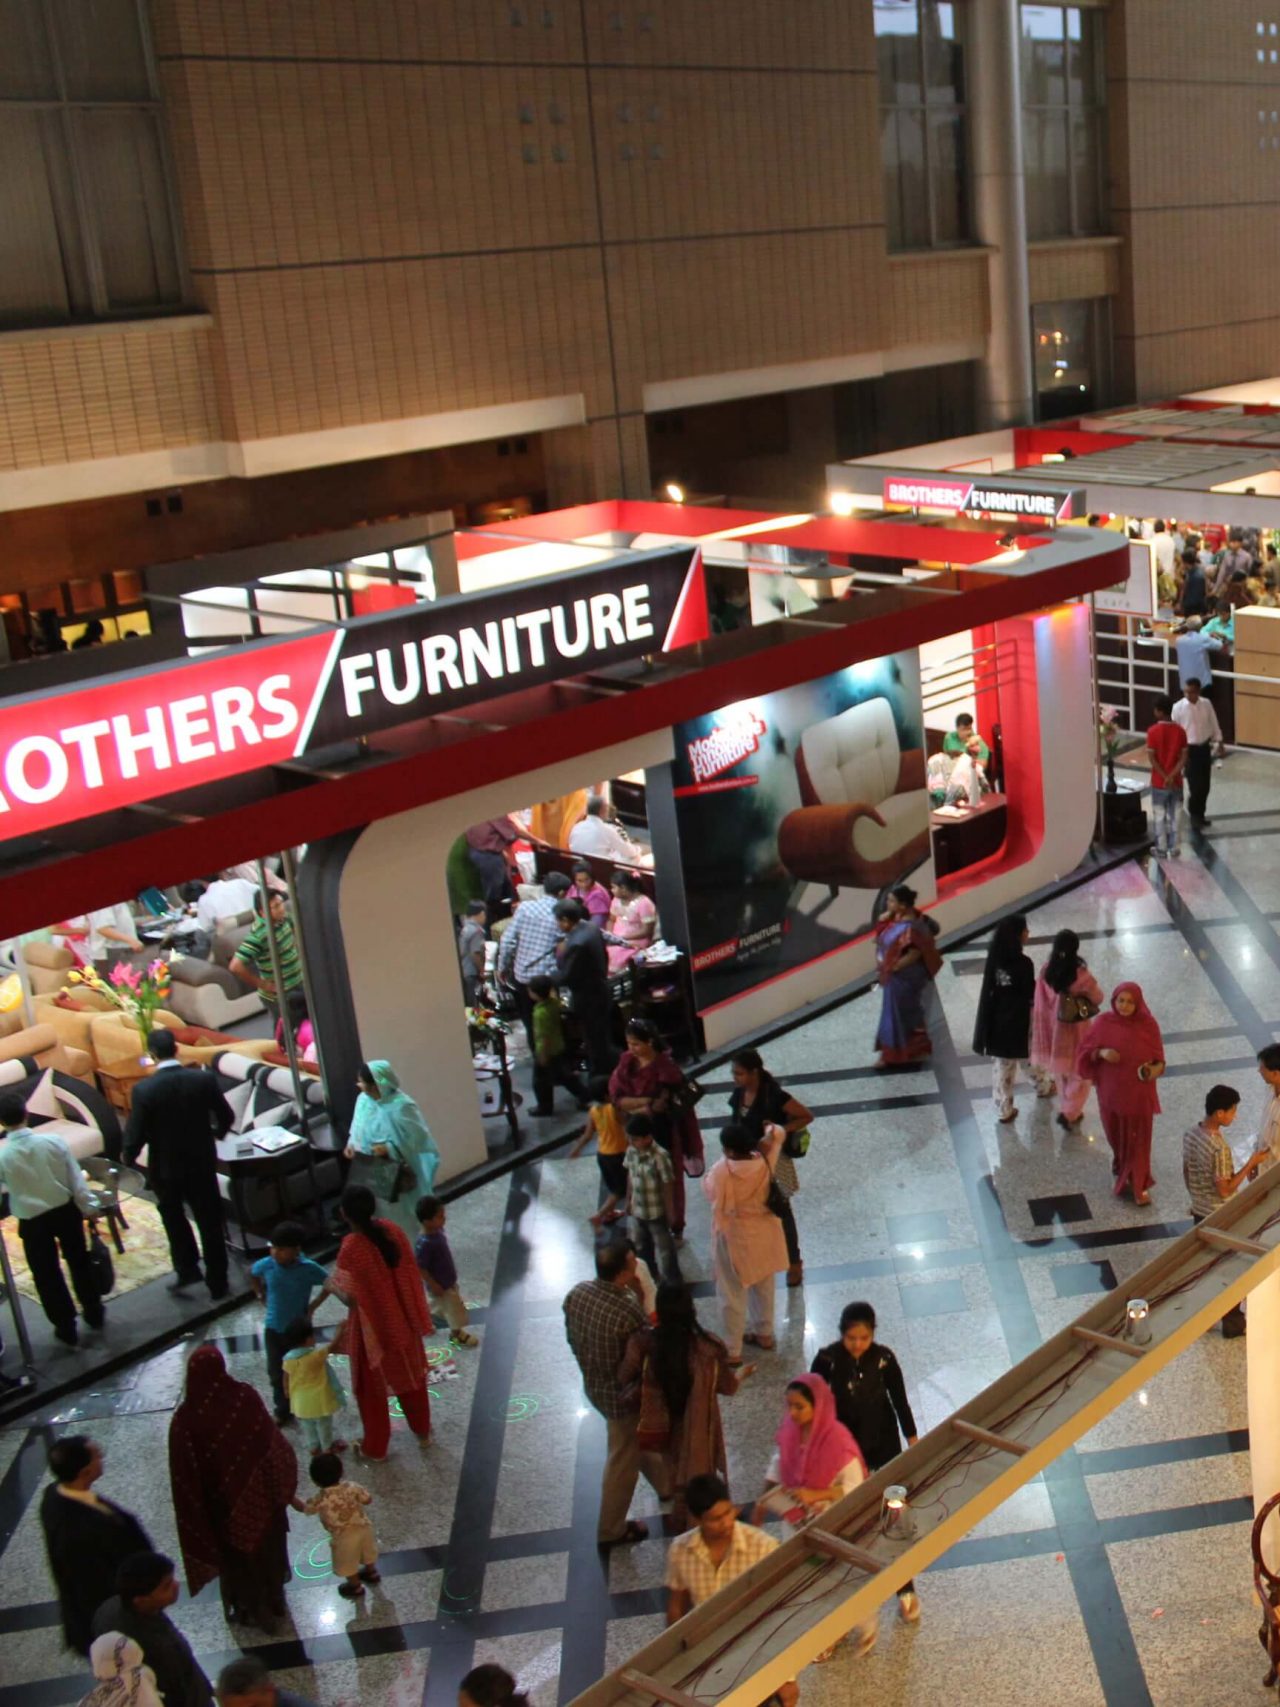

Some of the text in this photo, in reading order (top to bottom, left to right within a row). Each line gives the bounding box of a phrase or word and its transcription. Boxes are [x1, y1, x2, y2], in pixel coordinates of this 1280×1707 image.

[888, 483, 1055, 514] BROTHERS FURNITURE
[0, 584, 654, 813] OTHERS FURNITURE
[694, 943, 736, 968] BROTHERS
[739, 922, 781, 948] FURNITURE
